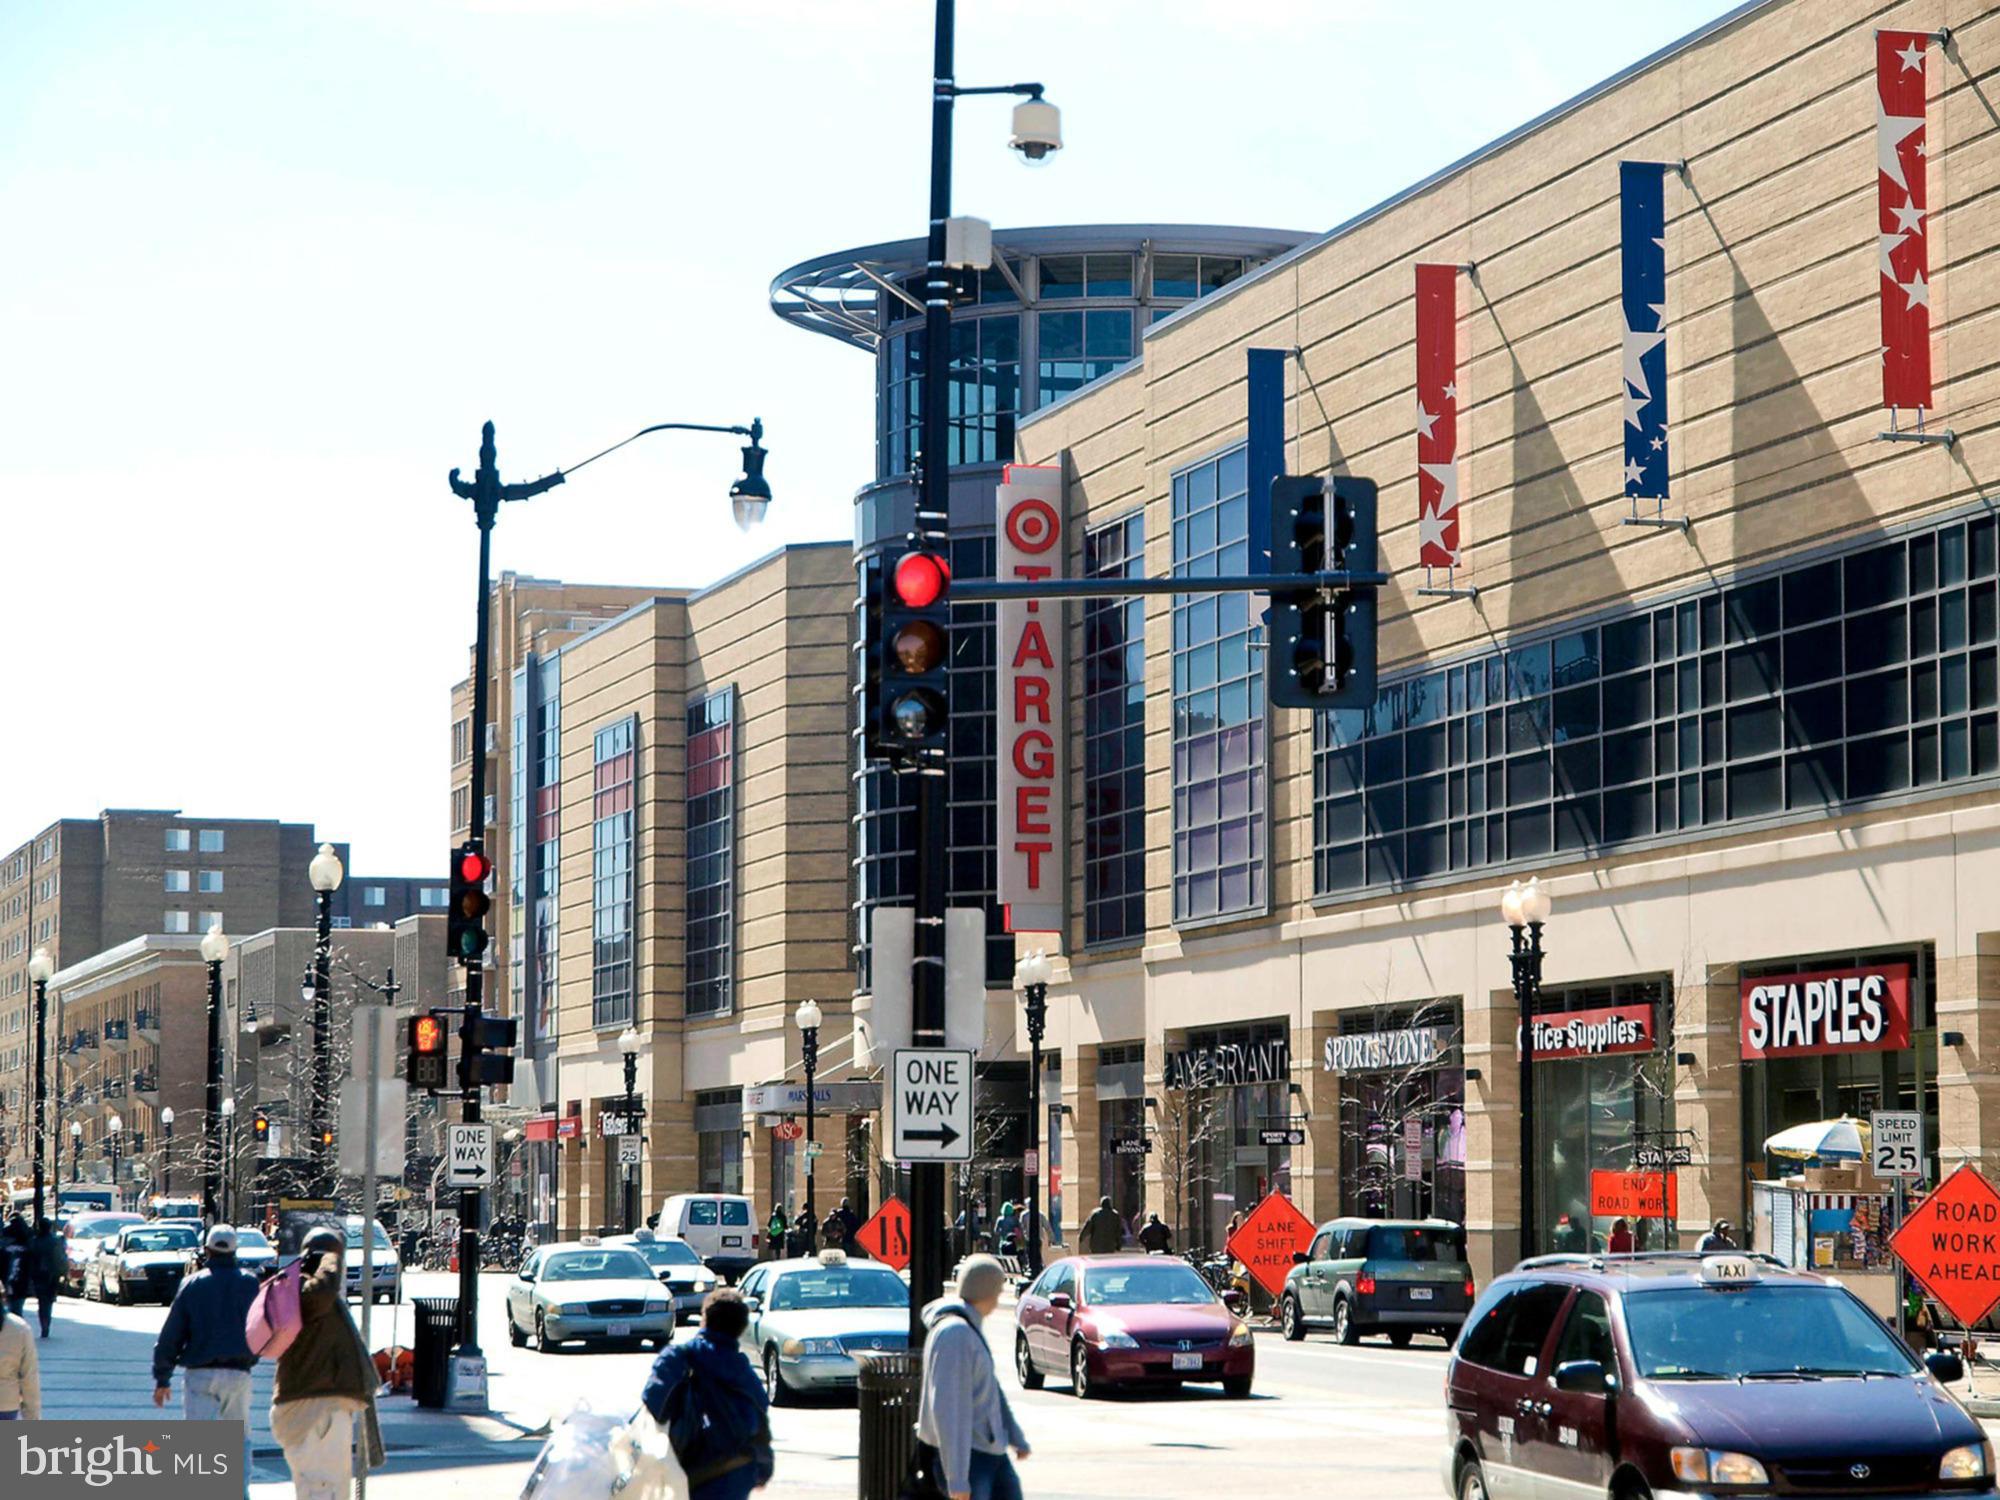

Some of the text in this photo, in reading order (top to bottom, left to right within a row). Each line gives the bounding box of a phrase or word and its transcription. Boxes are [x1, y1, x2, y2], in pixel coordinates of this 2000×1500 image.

[1011, 565, 1055, 890] TARGET
[1749, 974, 1886, 1050] STAPLES
[1566, 1015, 1638, 1053] Supplies
[1215, 1040, 1284, 1086] BRYANT
[907, 1060, 959, 1085] ONE
[905, 1091, 960, 1115] WAY
[1878, 1119, 1917, 1129] SPEED
[456, 1129, 486, 1144] ONE
[1881, 1132, 1912, 1142] LIMIT
[455, 1147, 487, 1161] WAY
[621, 1151, 637, 1161] 25
[1878, 1146, 1917, 1170] 25
[1623, 1178, 1647, 1191] END
[1599, 1197, 1671, 1210] ROAD WOR
[1936, 1202, 1998, 1222] ROAD
[1257, 1221, 1295, 1233] LANE
[1257, 1238, 1296, 1249] SHIFT
[1932, 1233, 1997, 1253] WORK
[1253, 1254, 1292, 1265] AHEA
[1716, 1264, 1746, 1277] TAXI
[1928, 1263, 2000, 1281] AHEAD
